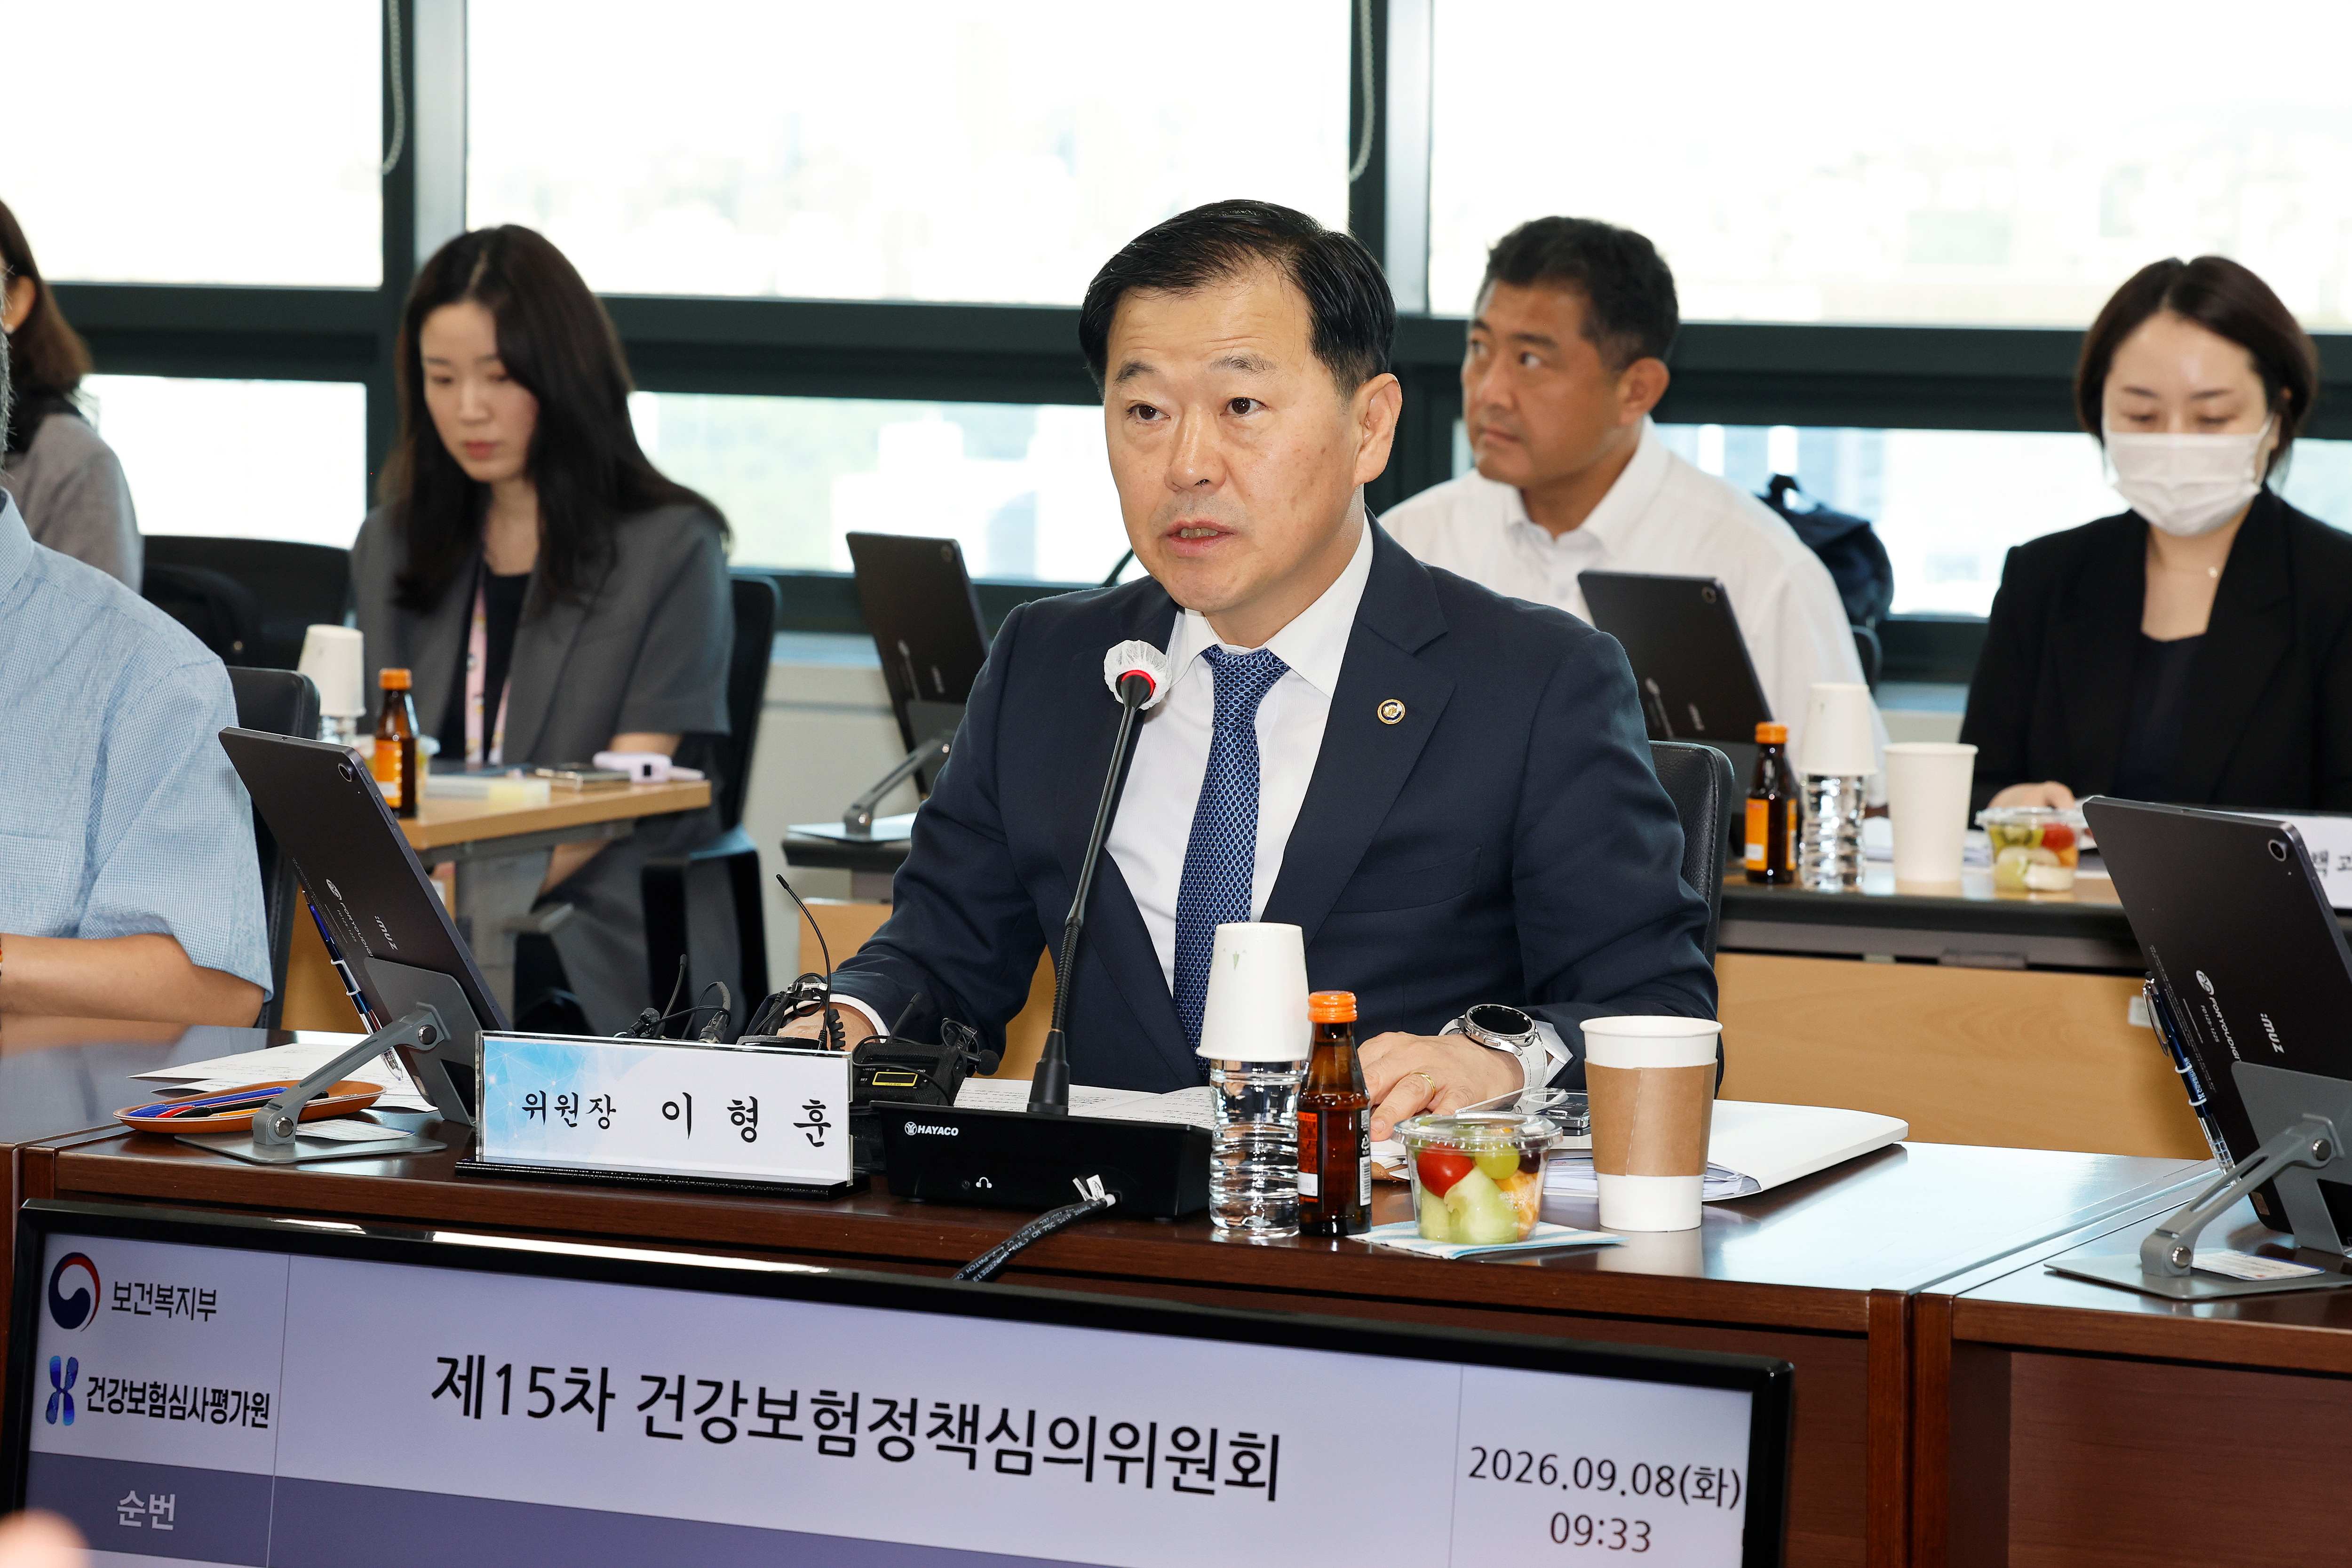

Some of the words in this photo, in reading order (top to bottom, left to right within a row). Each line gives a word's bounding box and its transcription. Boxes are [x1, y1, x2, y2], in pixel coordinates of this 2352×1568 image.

[340, 902, 375, 958] FORYOUDIGI
[522, 1090, 616, 1129] 위원장
[917, 1125, 959, 1136] HAYACO
[111, 1281, 217, 1321] 보건복지부
[87, 1377, 270, 1428] 건강보험심사평가원
[432, 1355, 615, 1432] 제15차
[637, 1374, 1279, 1502] 건강보험정책심의위원회
[1469, 1447, 1740, 1509] 2026.09.08(화)
[117, 1490, 175, 1530] 순번
[1550, 1512, 1651, 1552] 09:33
